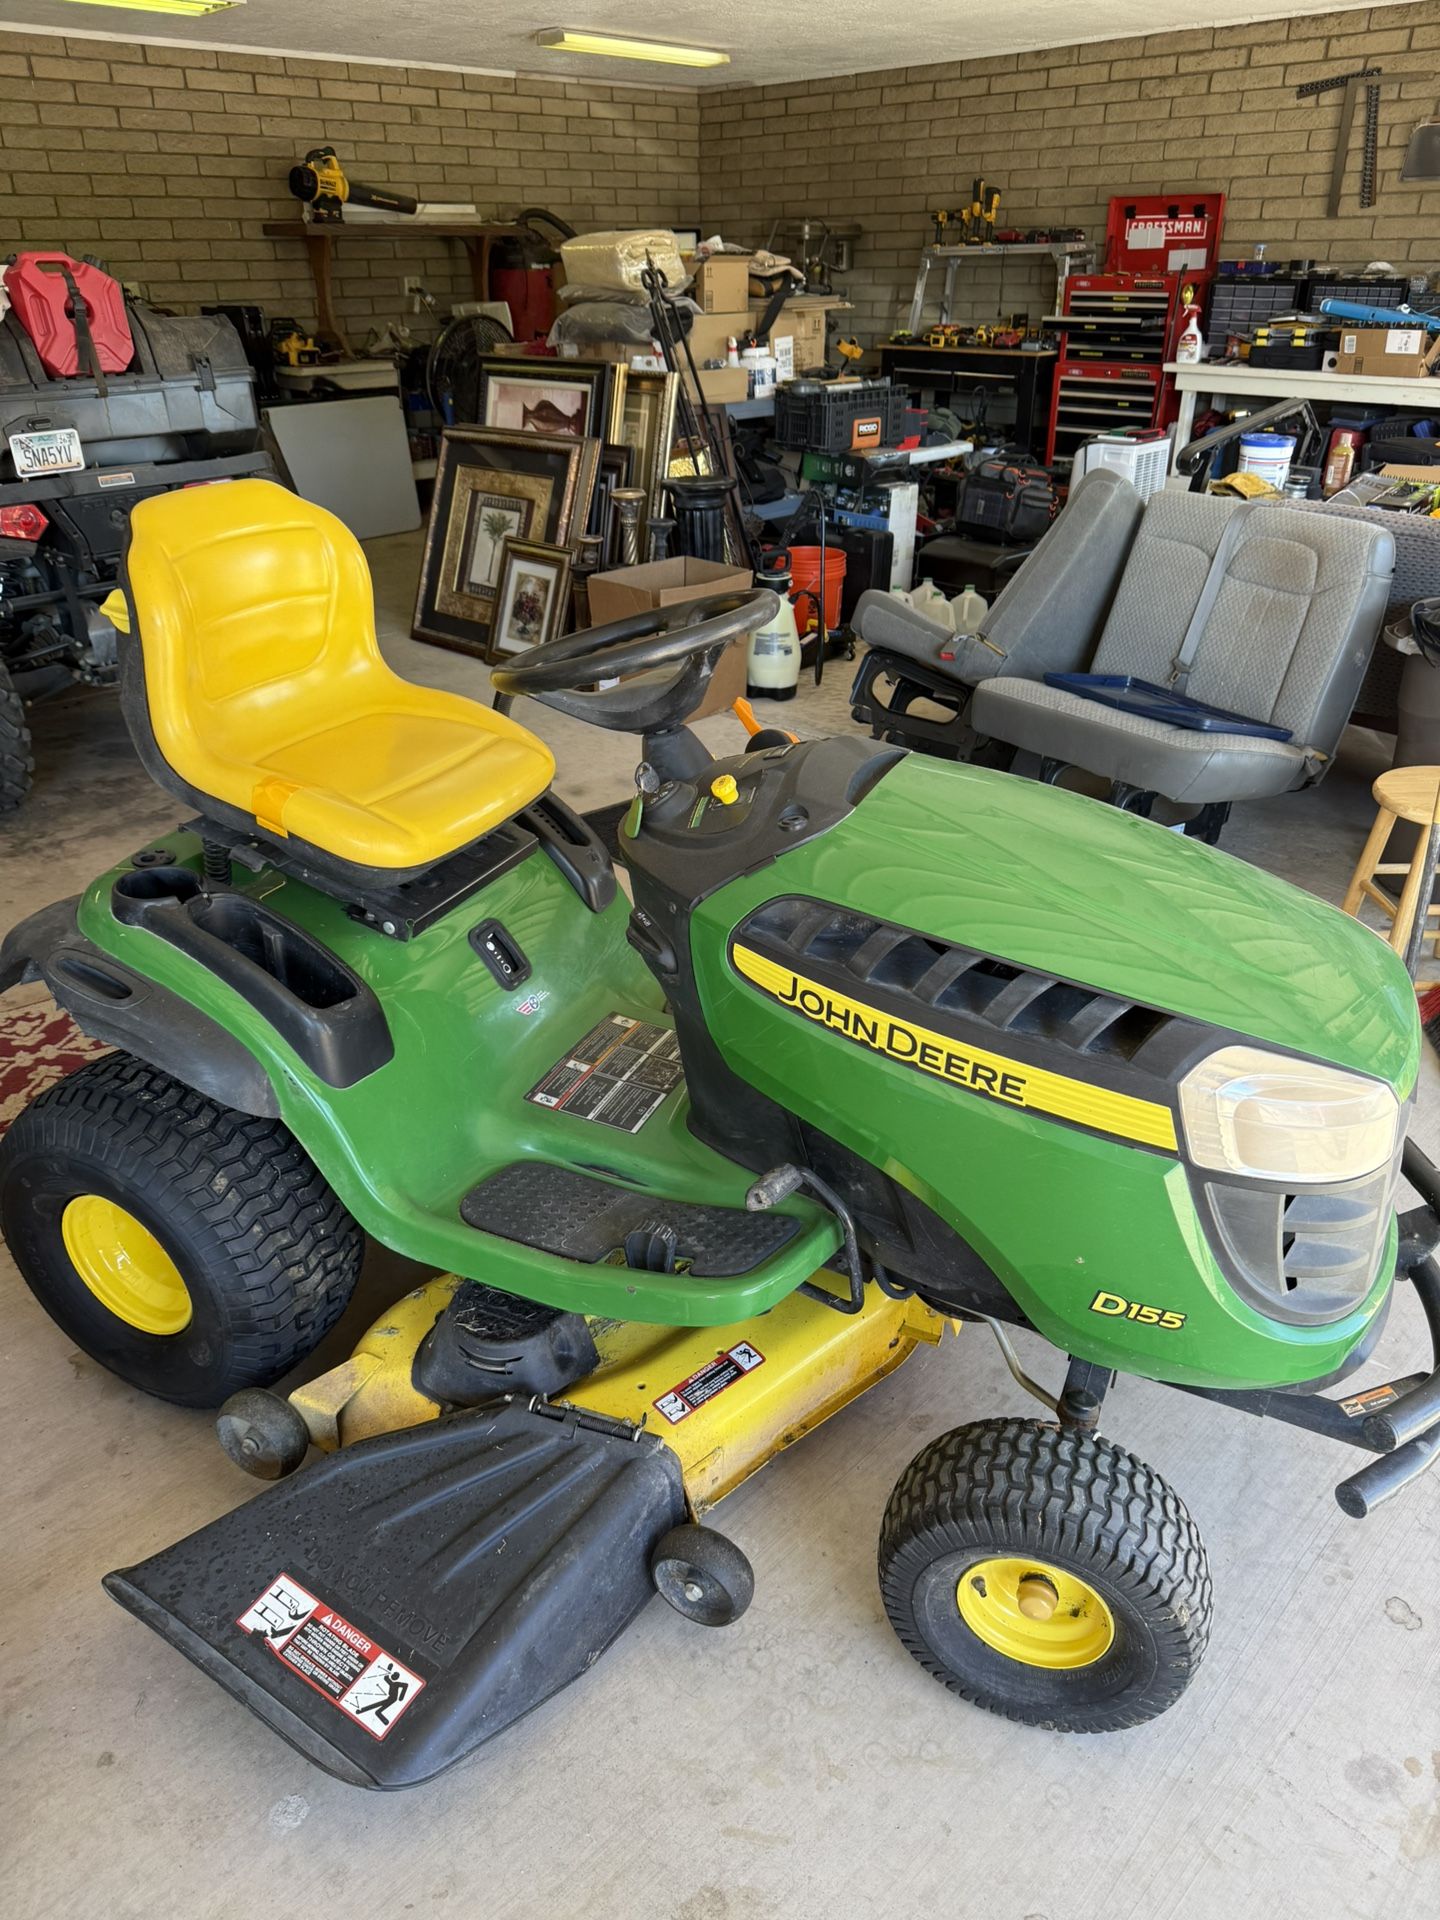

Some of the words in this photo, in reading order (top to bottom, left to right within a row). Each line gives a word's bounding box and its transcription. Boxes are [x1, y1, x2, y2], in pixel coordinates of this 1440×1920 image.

[23, 445, 73, 468] SNA5YV
[778, 976, 880, 1043] JOHN
[887, 1023, 1027, 1103] DEERE
[1090, 1290, 1187, 1329] D155
[306, 1635, 328, 1654] THROWN
[326, 1651, 350, 1671] OBJECTS
[318, 1624, 343, 1645] ROTATING
[341, 1642, 358, 1657] BLADE
[331, 1618, 371, 1653] DANGER
